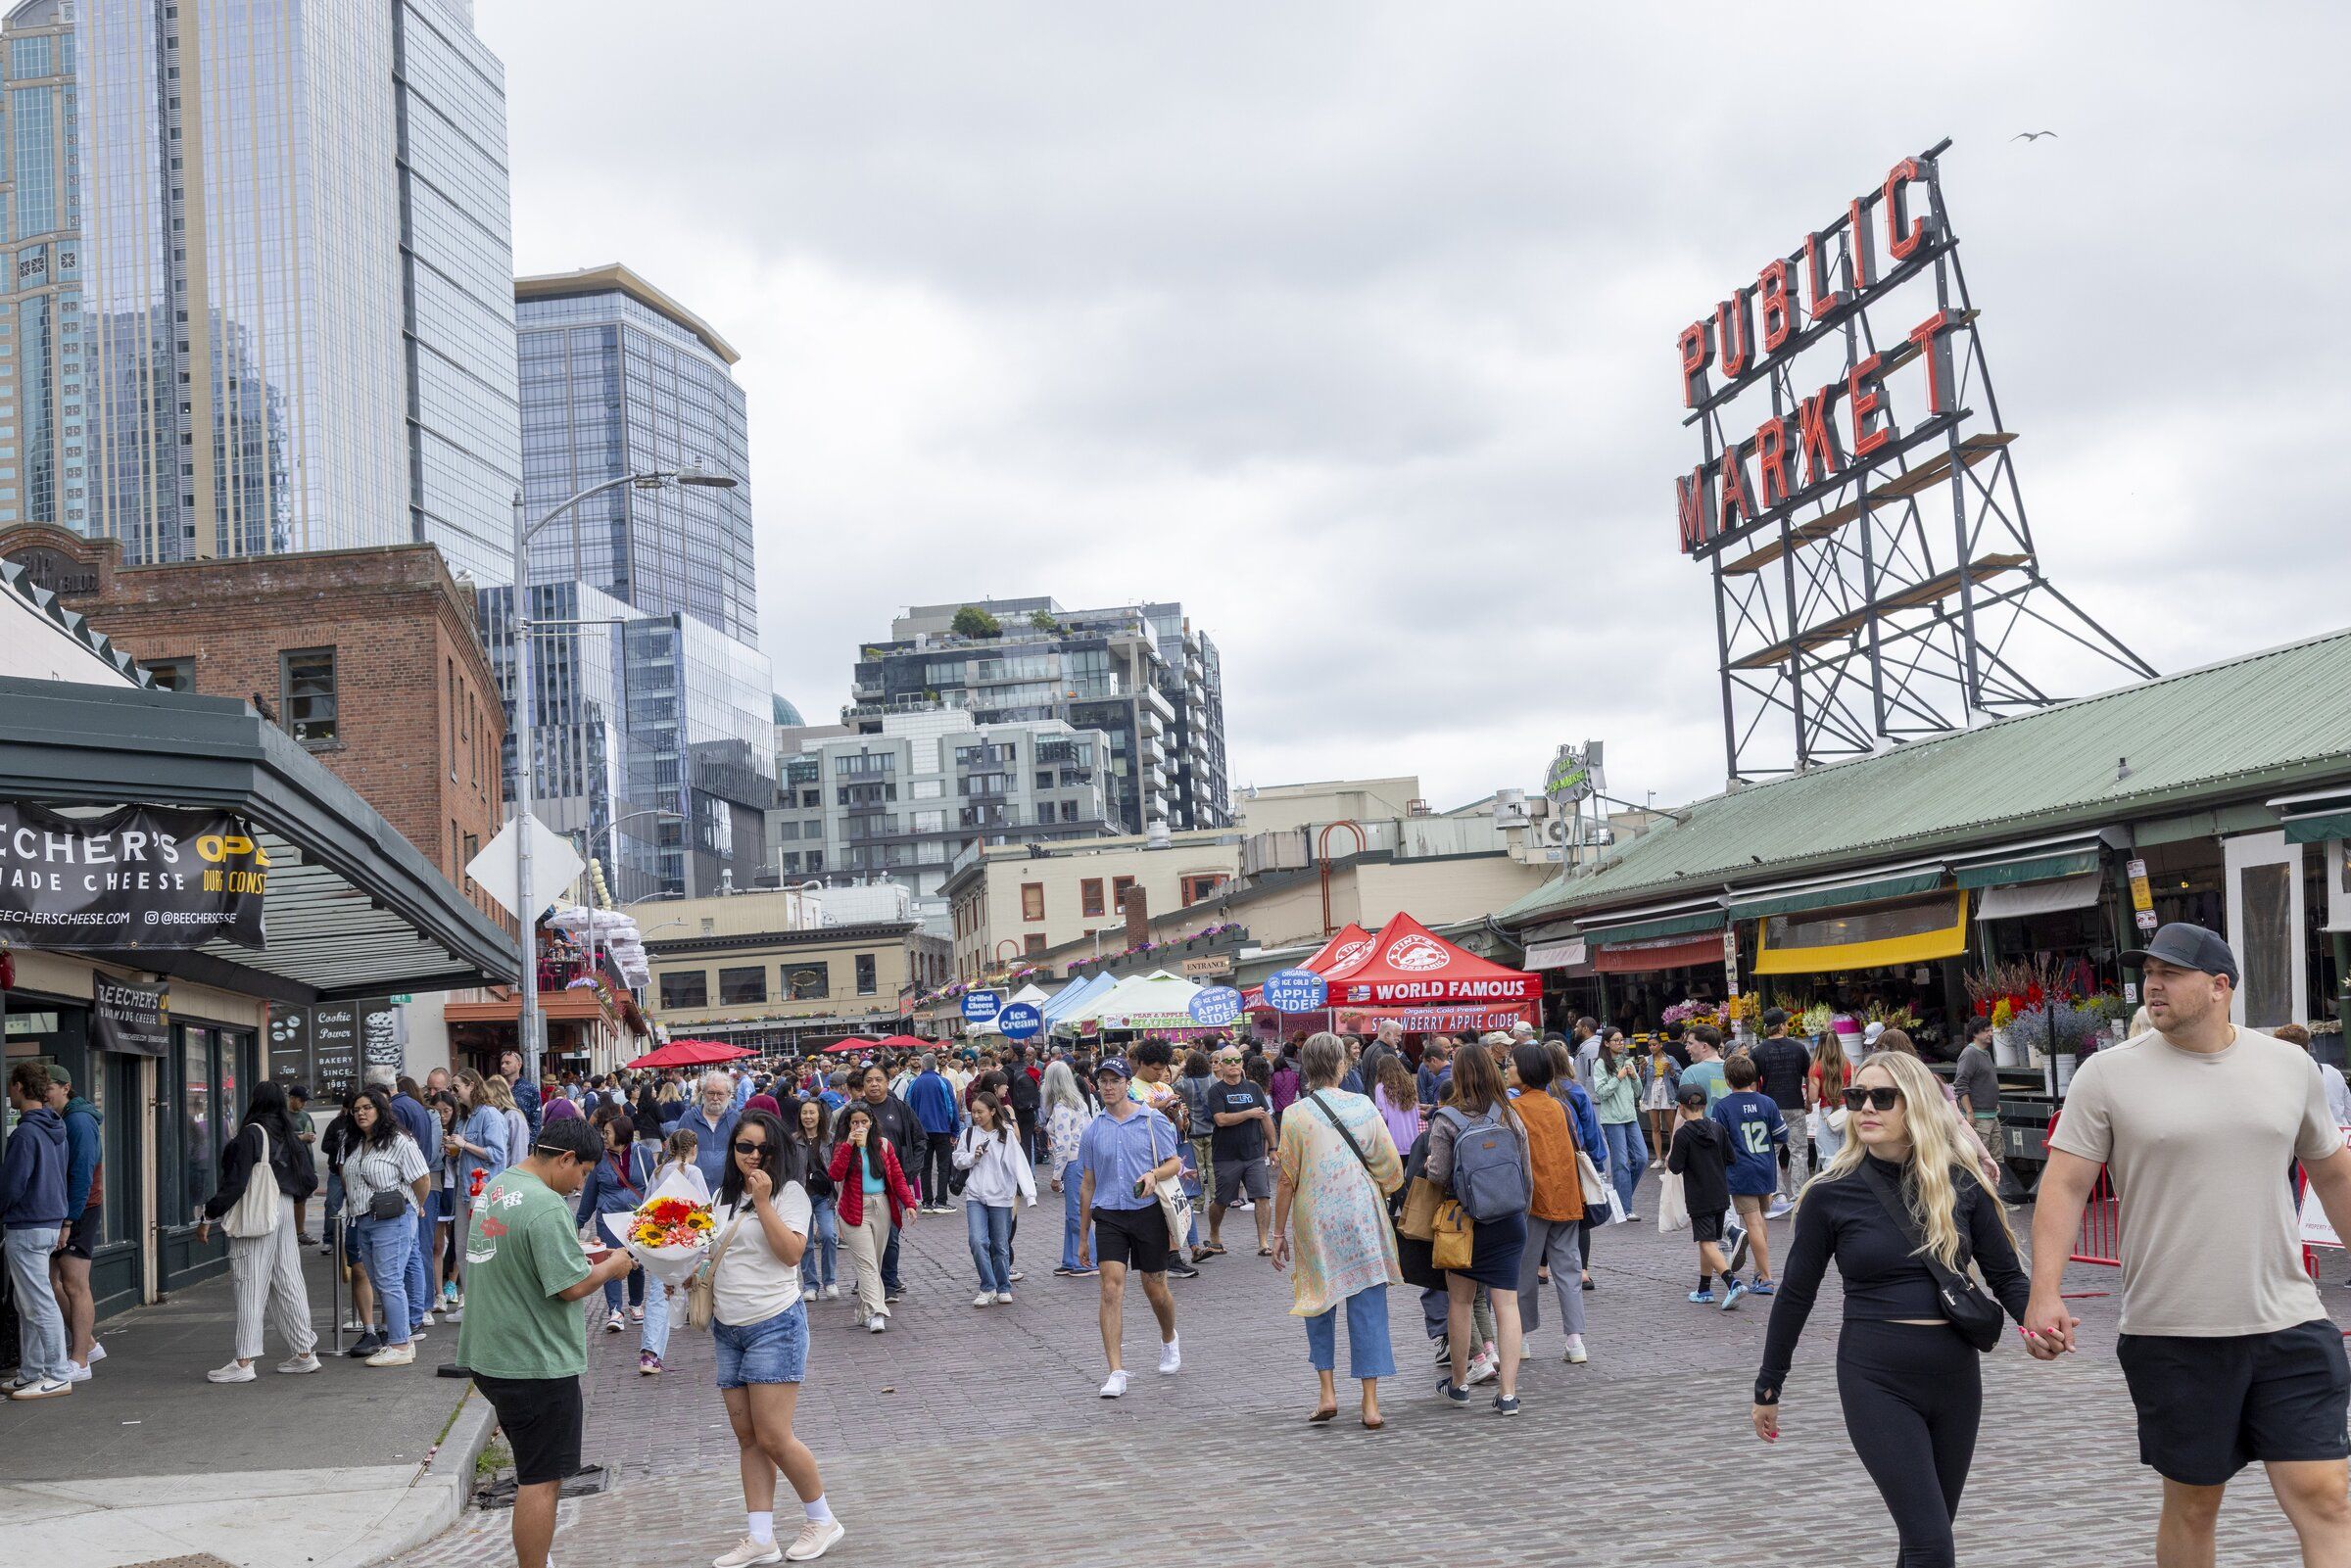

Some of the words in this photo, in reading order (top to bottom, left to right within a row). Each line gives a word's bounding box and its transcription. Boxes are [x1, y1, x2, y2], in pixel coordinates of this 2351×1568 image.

[1678, 155, 1938, 409] PUBLIC
[1674, 308, 1960, 555] MARKET
[0, 824, 179, 865] CHER'S
[0, 867, 62, 891] ADE
[83, 872, 185, 892] CHEESE
[1399, 960, 1445, 971] ORGANIC
[1201, 987, 1225, 997] ORGANIC
[1271, 989, 1320, 999] APPLE
[1375, 981, 1444, 1000] WORLD
[1449, 980, 1525, 997] FAMOUS
[98, 984, 159, 1010] BEECHER'S
[1212, 993, 1226, 1002] COLD
[1198, 1000, 1238, 1017] APPLE
[1271, 998, 1320, 1012] CIDER
[135, 1012, 157, 1024] CHEESE
[317, 1012, 352, 1023] Cookie
[1010, 1010, 1028, 1020] Ice
[1198, 1009, 1239, 1024] CIDER
[1001, 1019, 1038, 1030] Cream
[1371, 1016, 1445, 1031] STAWBERRY
[1449, 1014, 1482, 1029] APPLE
[1487, 1013, 1519, 1028] CIDER
[318, 1028, 352, 1040] Power
[318, 1056, 354, 1065] BAKERY
[279, 1066, 296, 1075] Tea
[322, 1068, 350, 1077] SINCE
[326, 1080, 347, 1090] 1985
[1743, 1104, 1757, 1114] FAN
[1741, 1120, 1770, 1154] 12
[2305, 1222, 2327, 1231] PROPERTY
